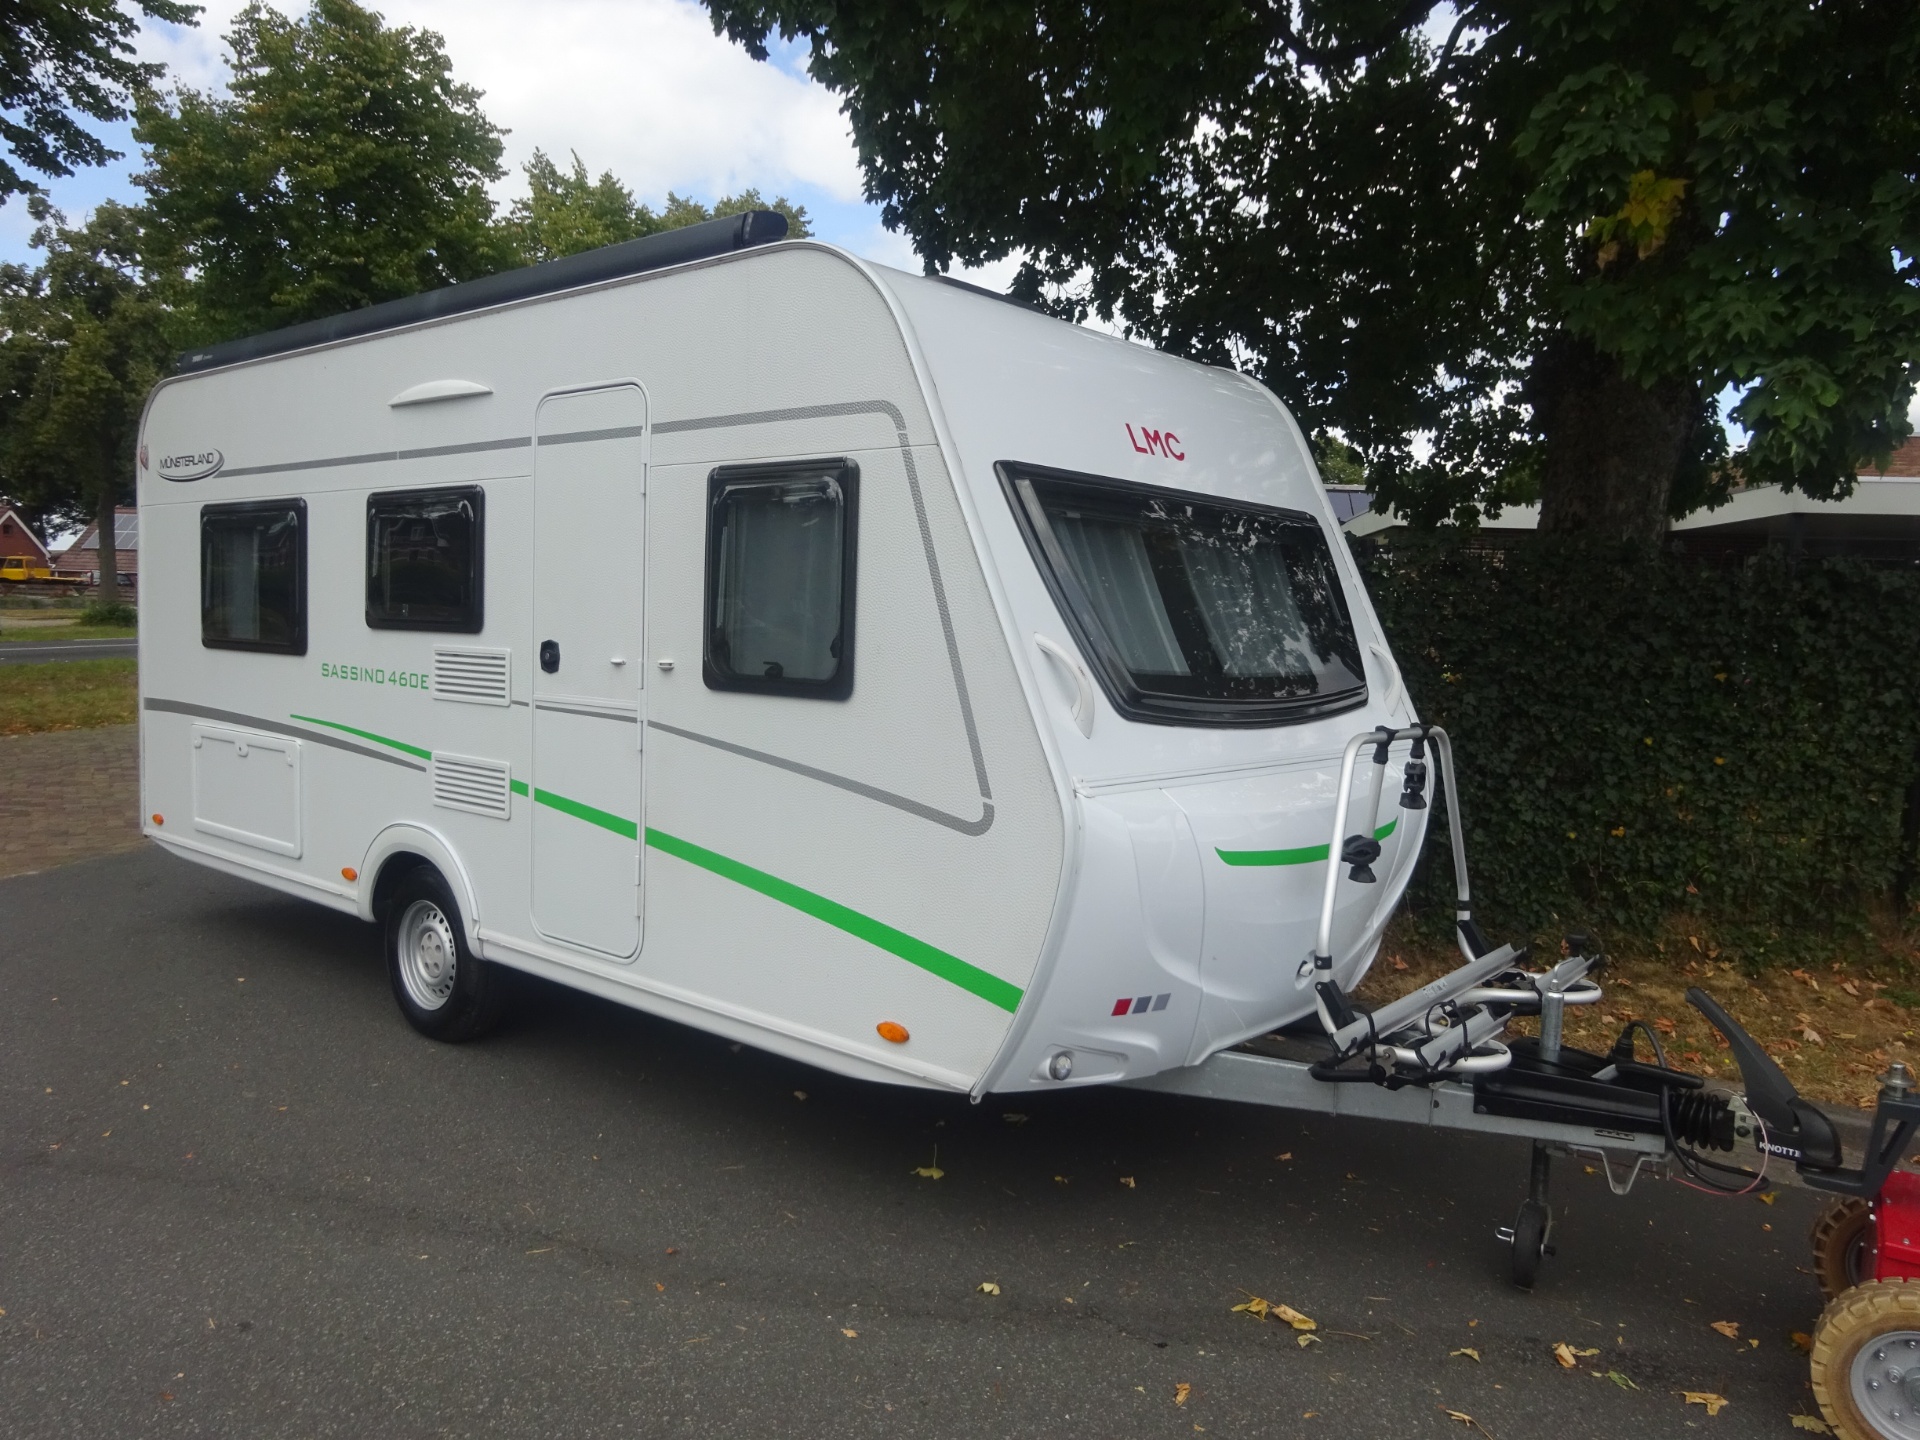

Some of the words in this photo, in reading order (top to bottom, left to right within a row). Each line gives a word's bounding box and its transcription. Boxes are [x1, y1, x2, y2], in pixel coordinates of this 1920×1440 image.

[1125, 423, 1185, 461] LMC
[160, 452, 214, 469] MÜNSTERLAND
[321, 663, 385, 684] SASSINO
[388, 671, 430, 690] 460E
